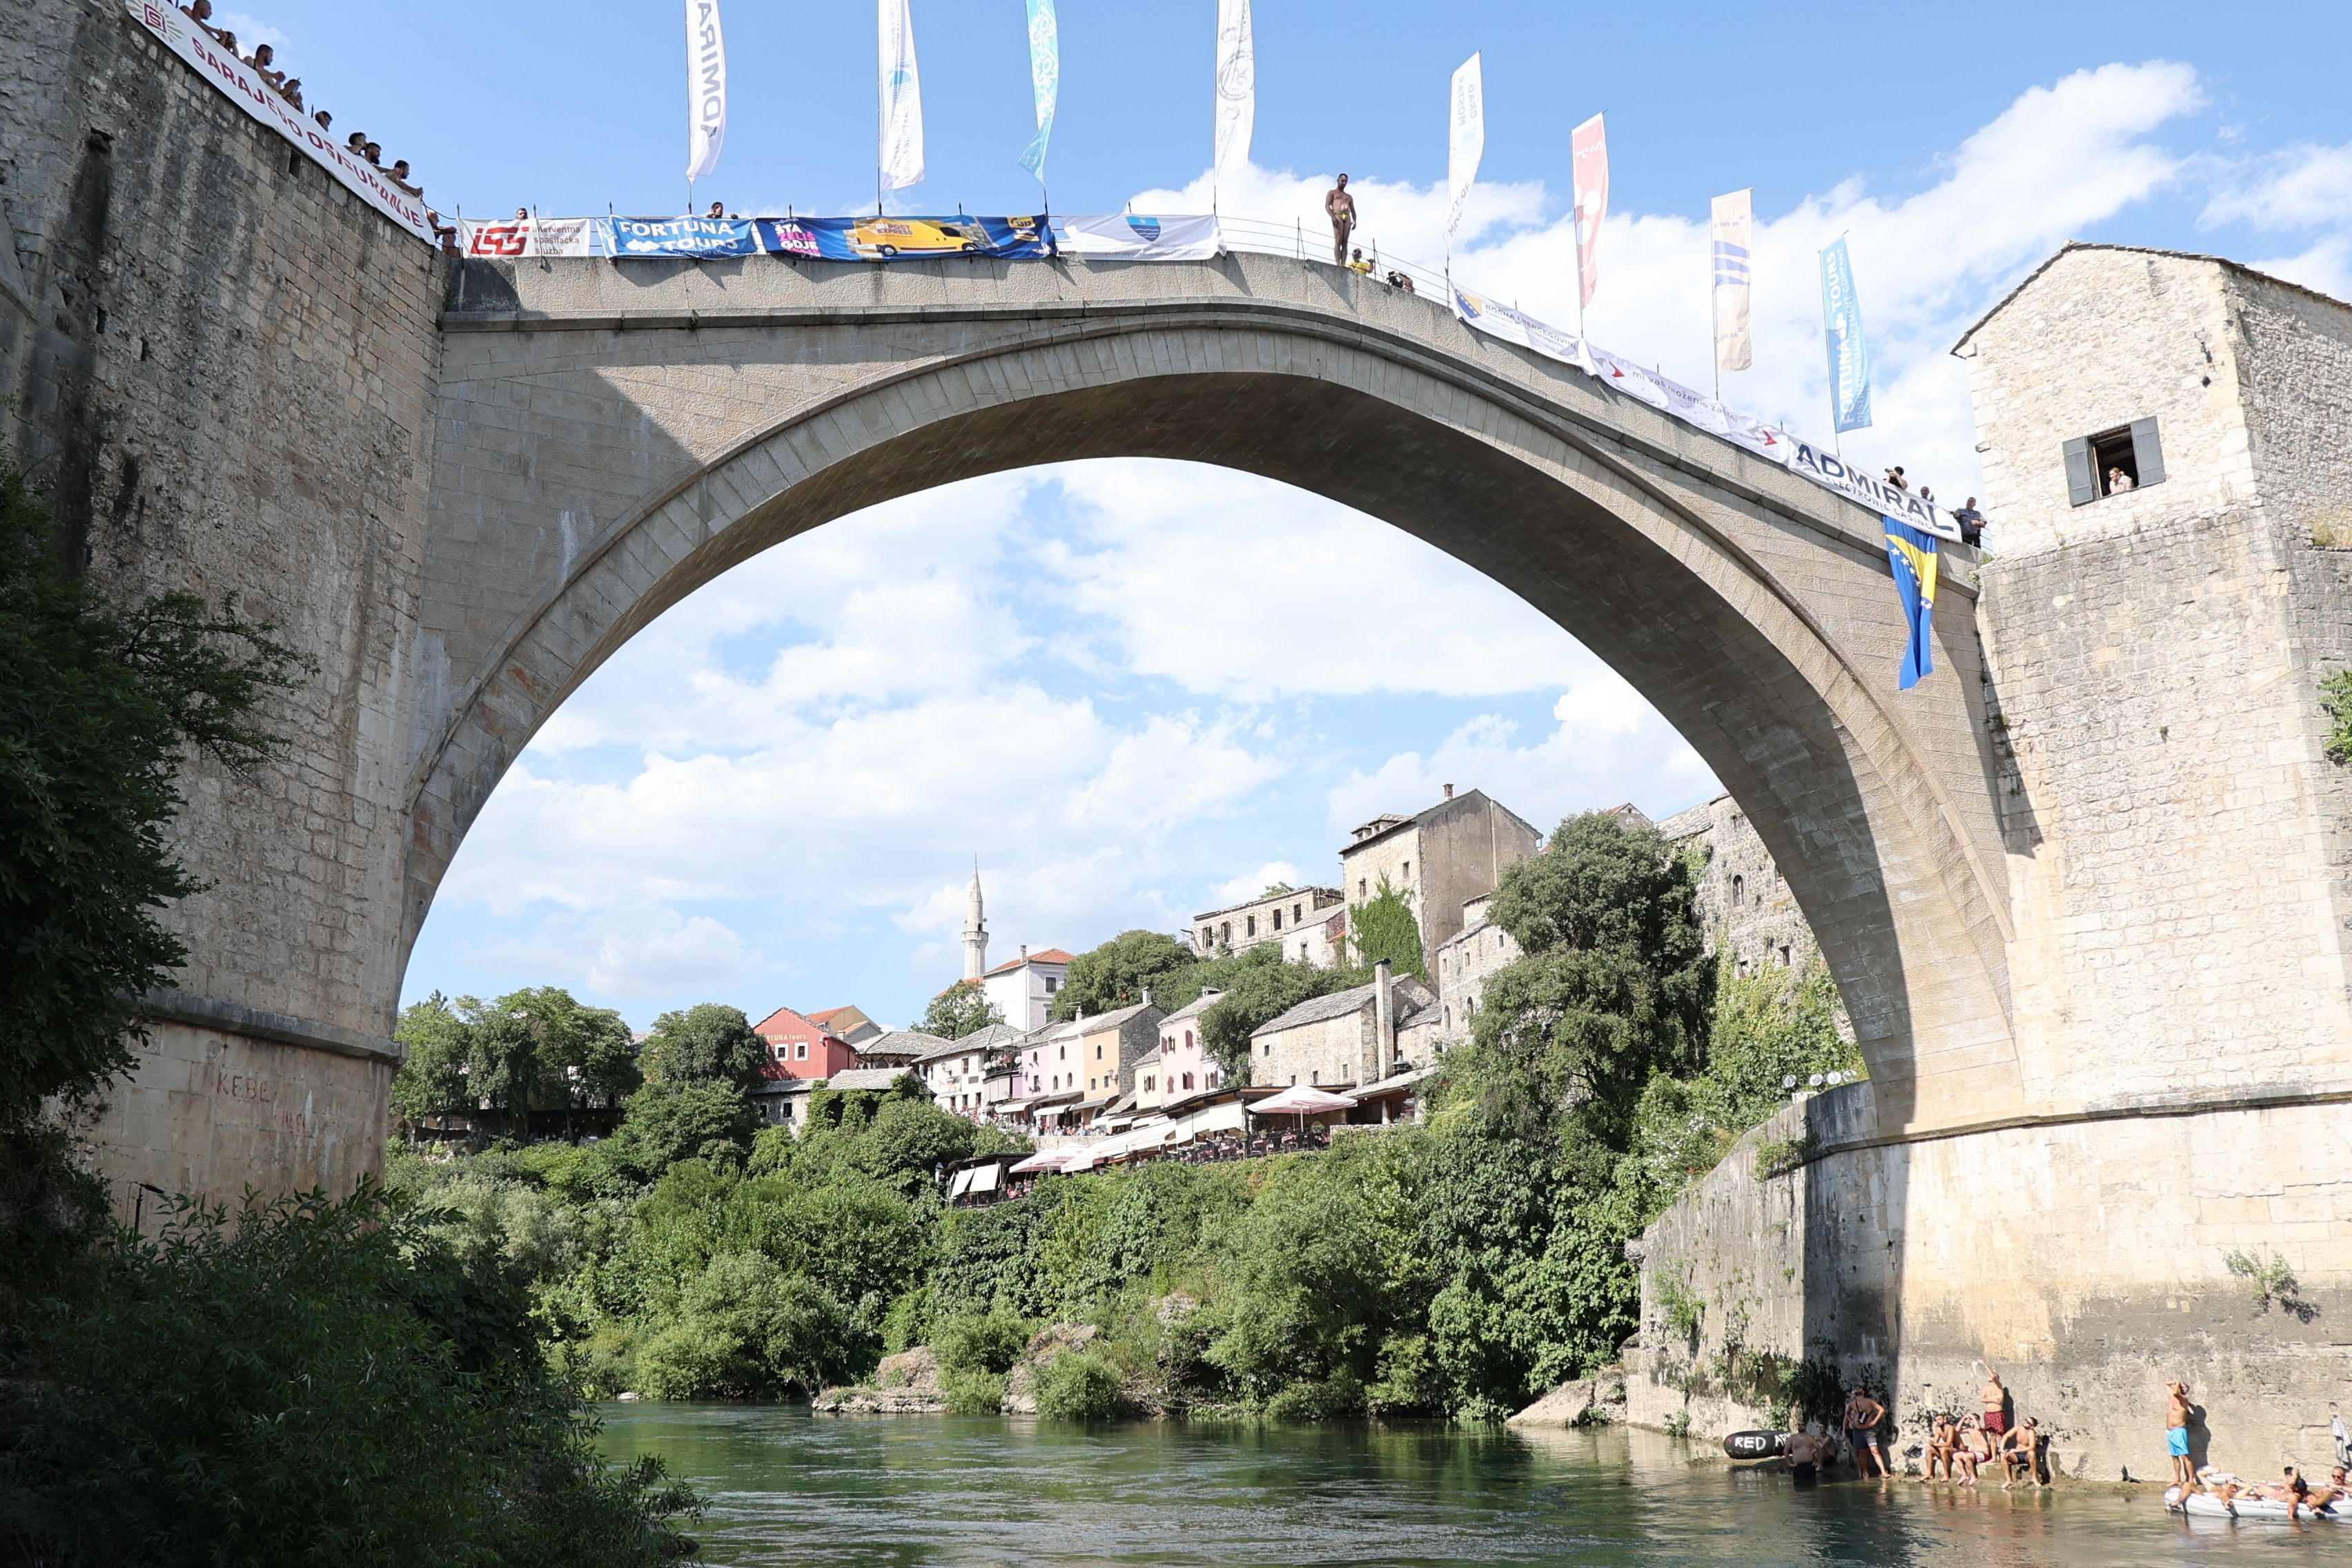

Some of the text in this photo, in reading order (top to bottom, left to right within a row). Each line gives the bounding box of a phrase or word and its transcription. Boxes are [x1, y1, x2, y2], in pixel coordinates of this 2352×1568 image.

[192, 37, 302, 137] SARAJEVO
[618, 220, 735, 237] FORTUNA
[781, 239, 819, 251] GDJE
[1826, 250, 1843, 313] TOURS
[1836, 248, 1850, 294] COMPANY
[1632, 371, 1645, 380] mi
[1649, 377, 1666, 387] vas
[1667, 385, 1707, 408] možemo
[1836, 337, 1855, 424] FORTUNA
[1796, 443, 1954, 532] ADMIRAL
[1825, 476, 1932, 530] ELECTRONIC CASINO
[1734, 1436, 1766, 1451] RED
